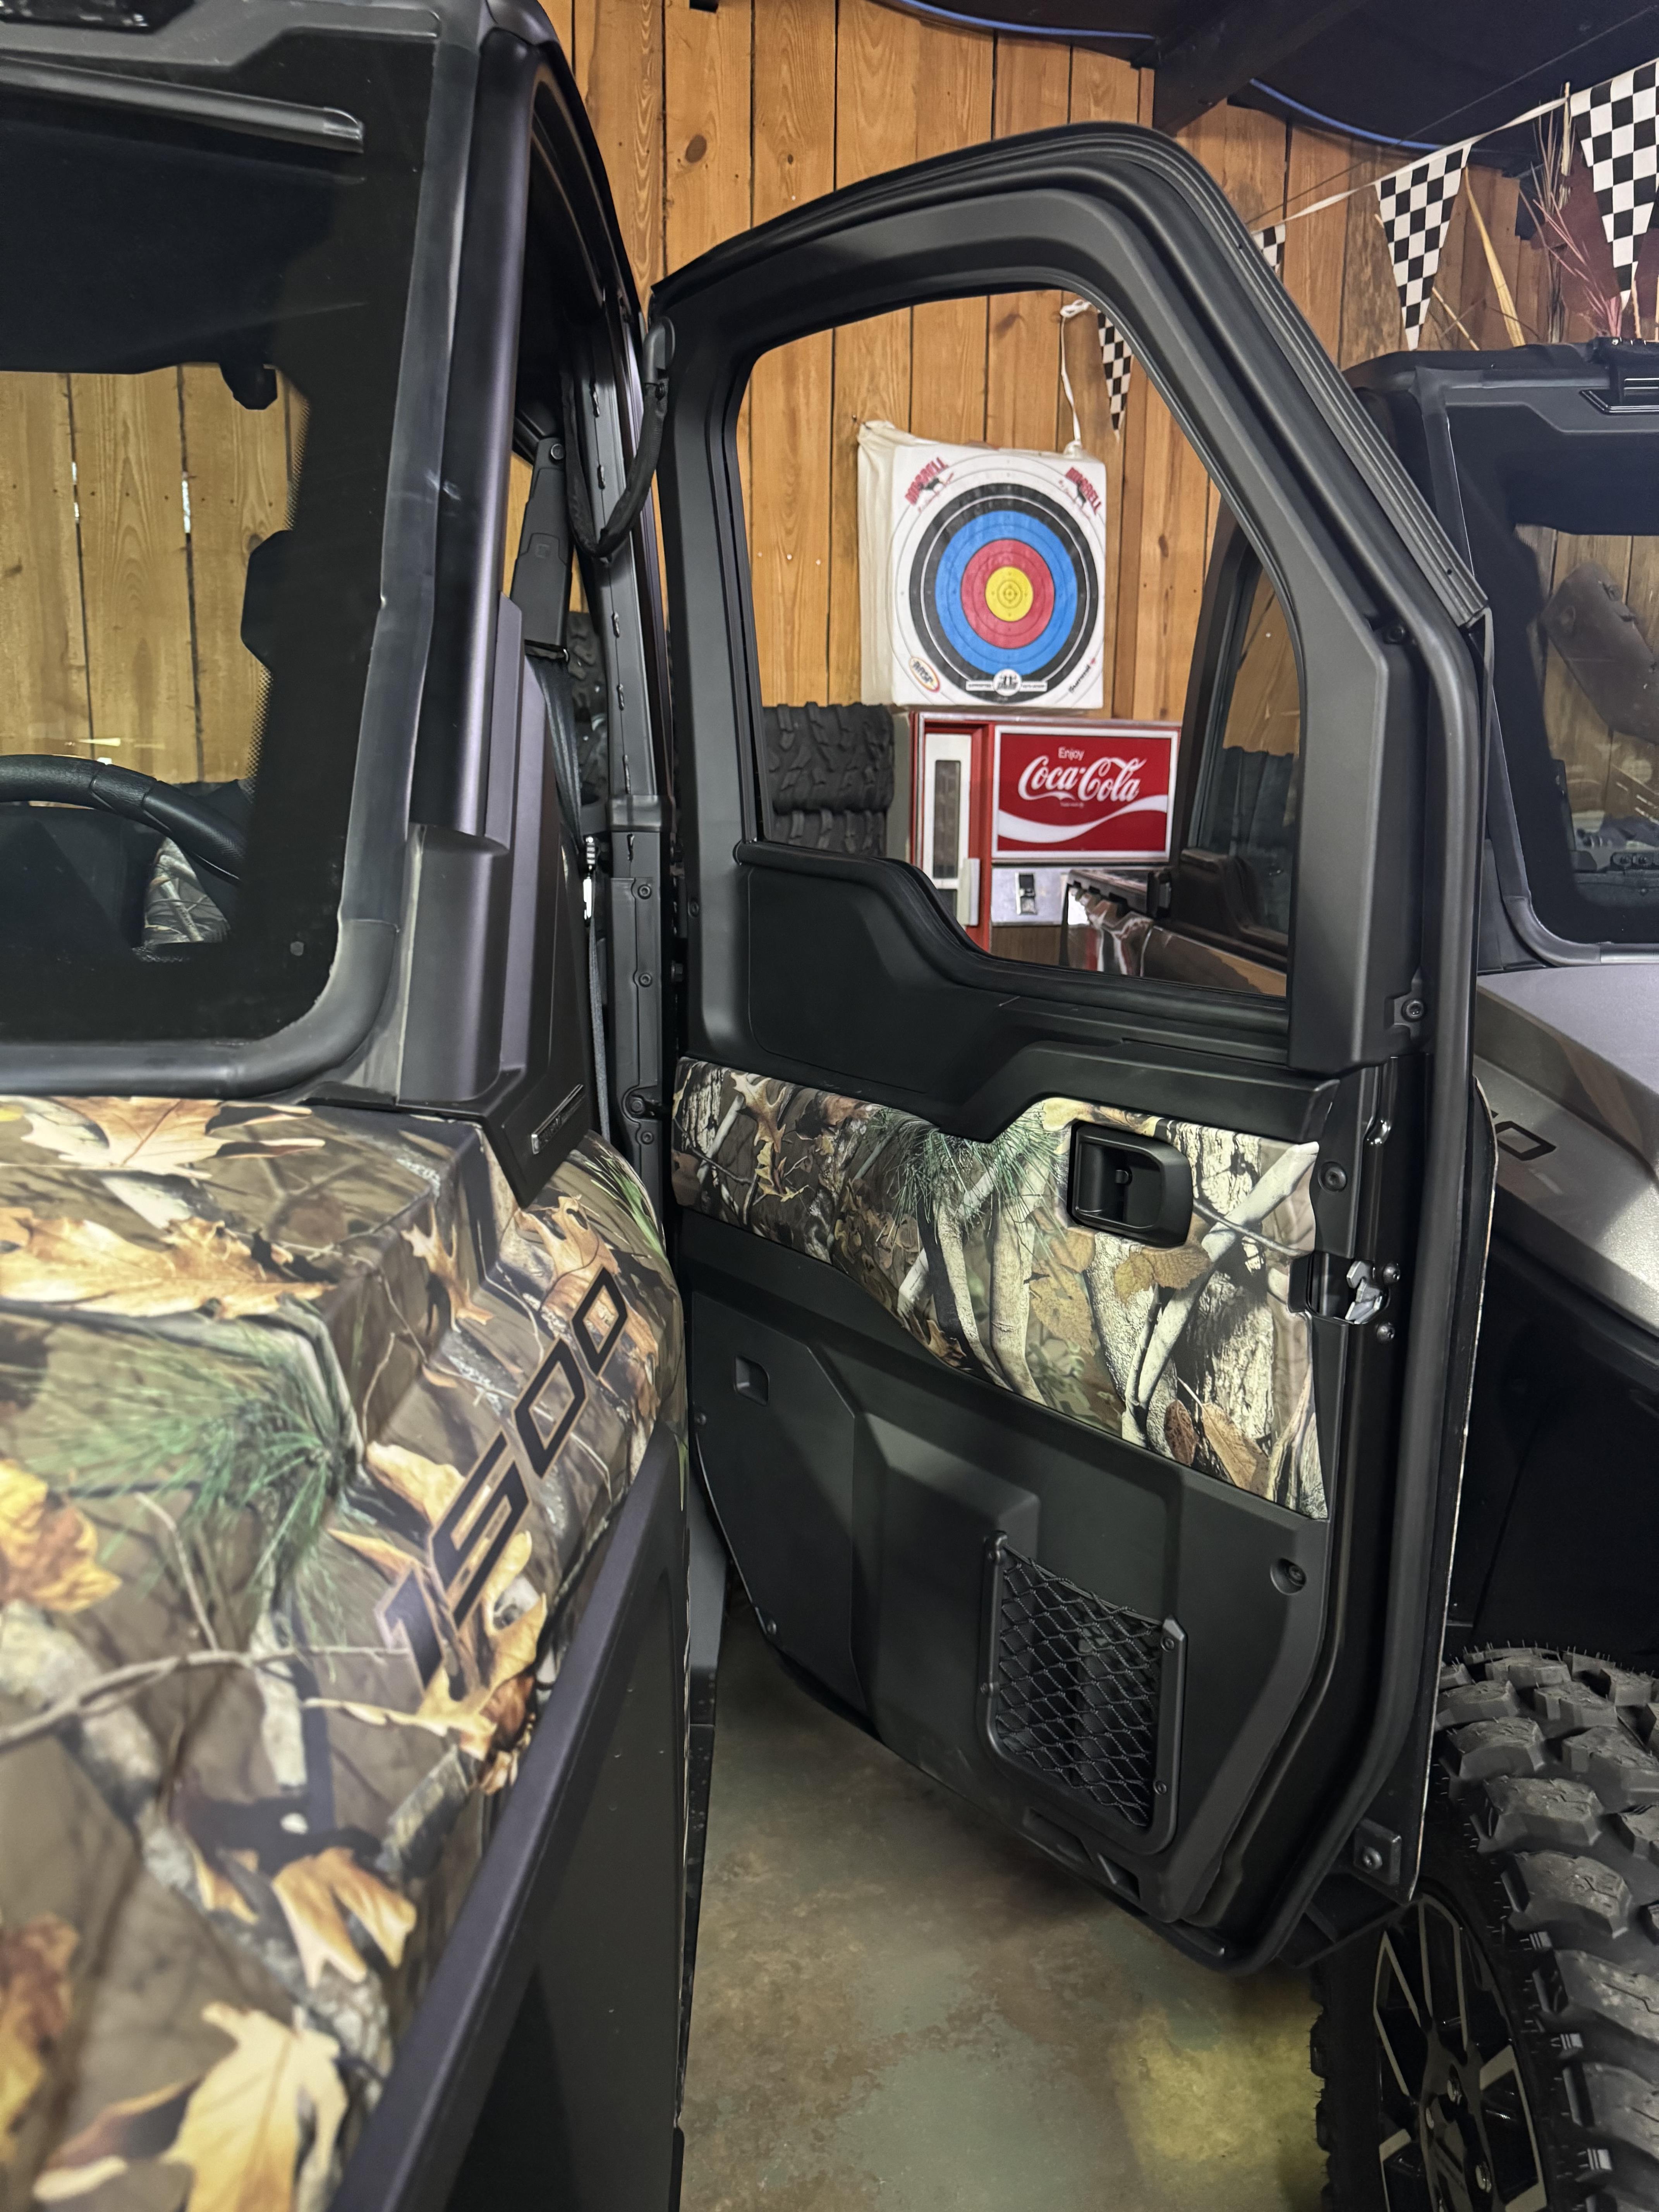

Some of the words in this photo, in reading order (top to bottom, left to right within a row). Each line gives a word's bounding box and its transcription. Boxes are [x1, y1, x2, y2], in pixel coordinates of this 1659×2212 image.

[1058, 747, 1084, 761] Enjoy
[1018, 755, 1147, 802] Coca-Cola
[374, 1265, 628, 1697] 1500
